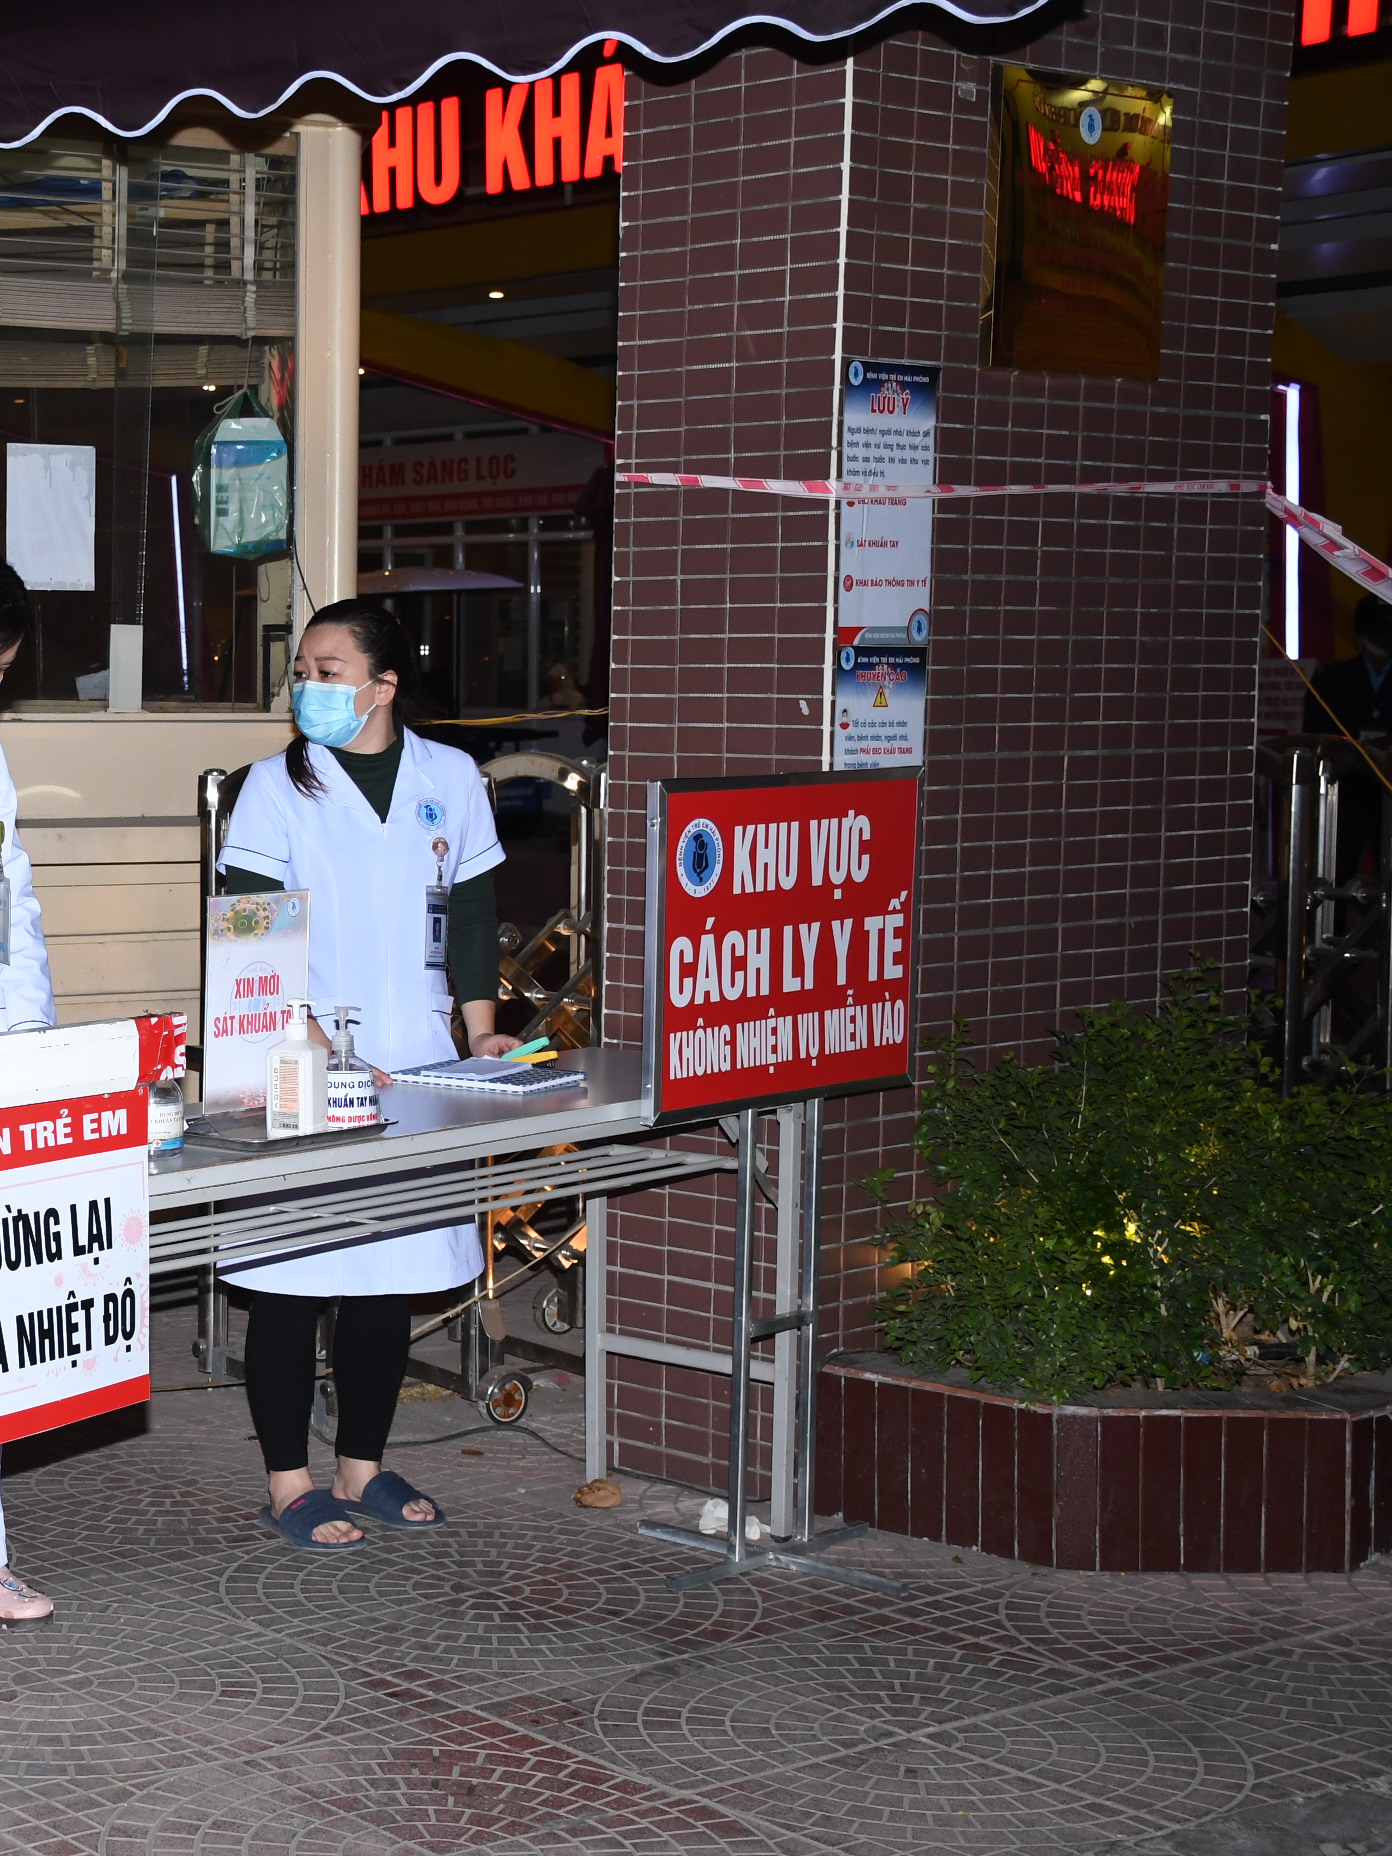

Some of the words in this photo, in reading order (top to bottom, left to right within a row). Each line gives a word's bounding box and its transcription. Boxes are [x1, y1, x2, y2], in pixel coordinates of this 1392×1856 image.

[360, 95, 460, 216] HU
[871, 393, 896, 414] LƯU
[901, 389, 911, 415] Ý
[361, 458, 406, 489] HÁM
[412, 455, 469, 486] SÀNG
[476, 453, 517, 486] LỌC
[857, 537, 866, 547] SÁT
[889, 540, 899, 548] TAY
[855, 579, 868, 587] KHAI
[871, 577, 883, 587] BÁO
[885, 577, 905, 587] THÔNG
[921, 576, 928, 587] TẾ
[888, 668, 908, 682] CÁO
[732, 821, 799, 895] KHU
[810, 810, 871, 899] VỰC
[669, 917, 771, 1008] CÁCH
[782, 922, 821, 993] LY
[831, 918, 853, 986] Y
[864, 890, 908, 982] TẾ
[234, 977, 254, 999] XIN
[258, 970, 280, 997] MỜI
[213, 1011, 235, 1038] SÁT
[239, 1003, 277, 1035] KHUẨN
[669, 1017, 731, 1080] KHÔNG
[736, 1008, 793, 1074] NHIỆM
[797, 1012, 820, 1066] VỤ
[824, 989, 868, 1055] MIỄN
[872, 992, 905, 1047] VÀO
[356, 1096, 368, 1107] TAY
[358, 1080, 375, 1089] DỊCH
[20, 1108, 73, 1150] TRẺ
[83, 1108, 128, 1140] EM
[327, 1115, 346, 1123] HÔNG
[70, 1196, 113, 1266] LẠI
[15, 1291, 95, 1368] NHIỆT
[102, 1276, 136, 1353] ĐỘ
